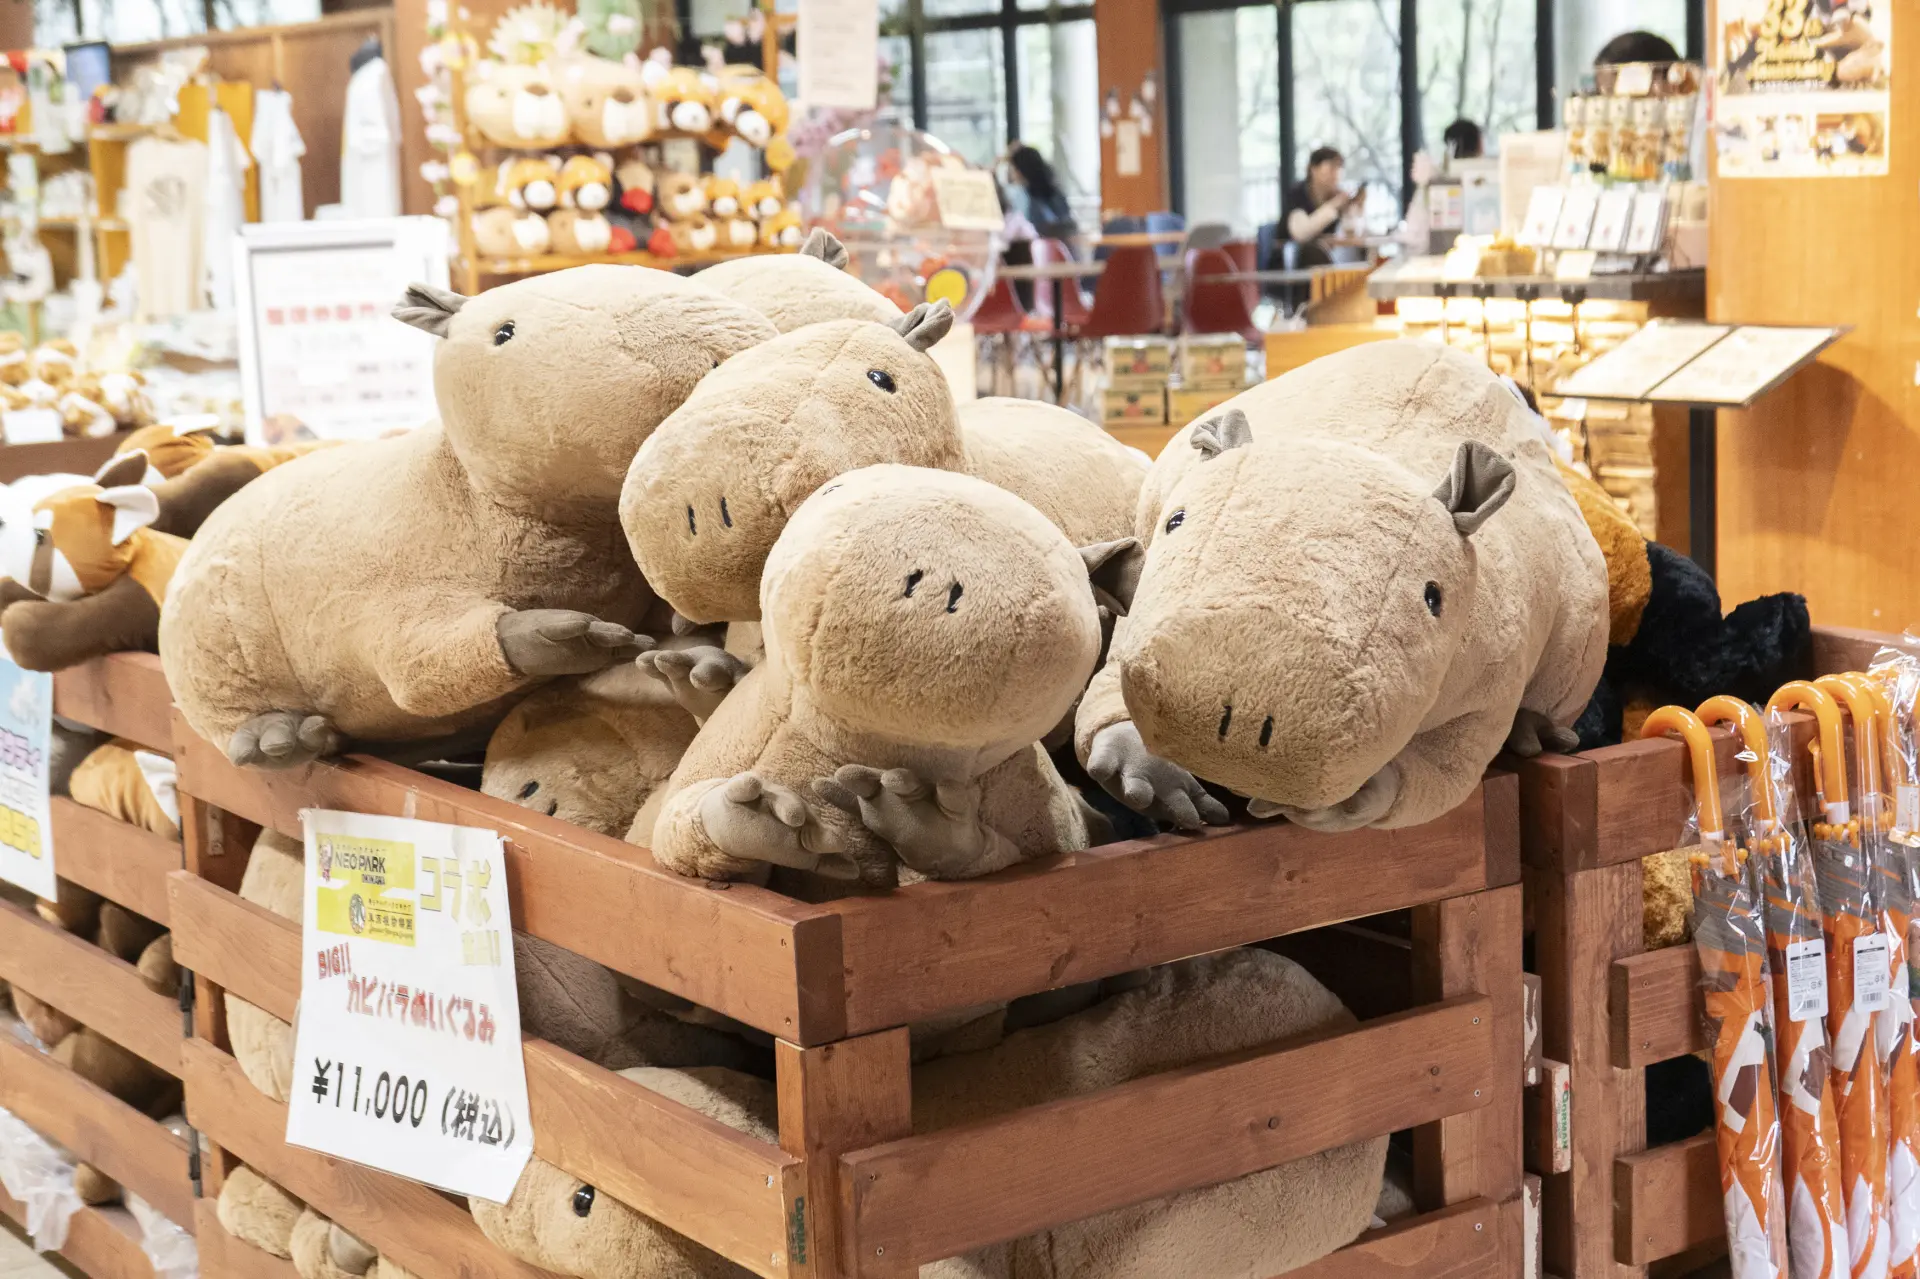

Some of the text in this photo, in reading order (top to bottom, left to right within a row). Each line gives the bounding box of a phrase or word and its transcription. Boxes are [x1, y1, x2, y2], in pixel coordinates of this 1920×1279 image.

[420, 856, 491, 926] コラボ
[317, 942, 351, 979] BIG!!
[312, 1056, 428, 1128] ¥11,000
